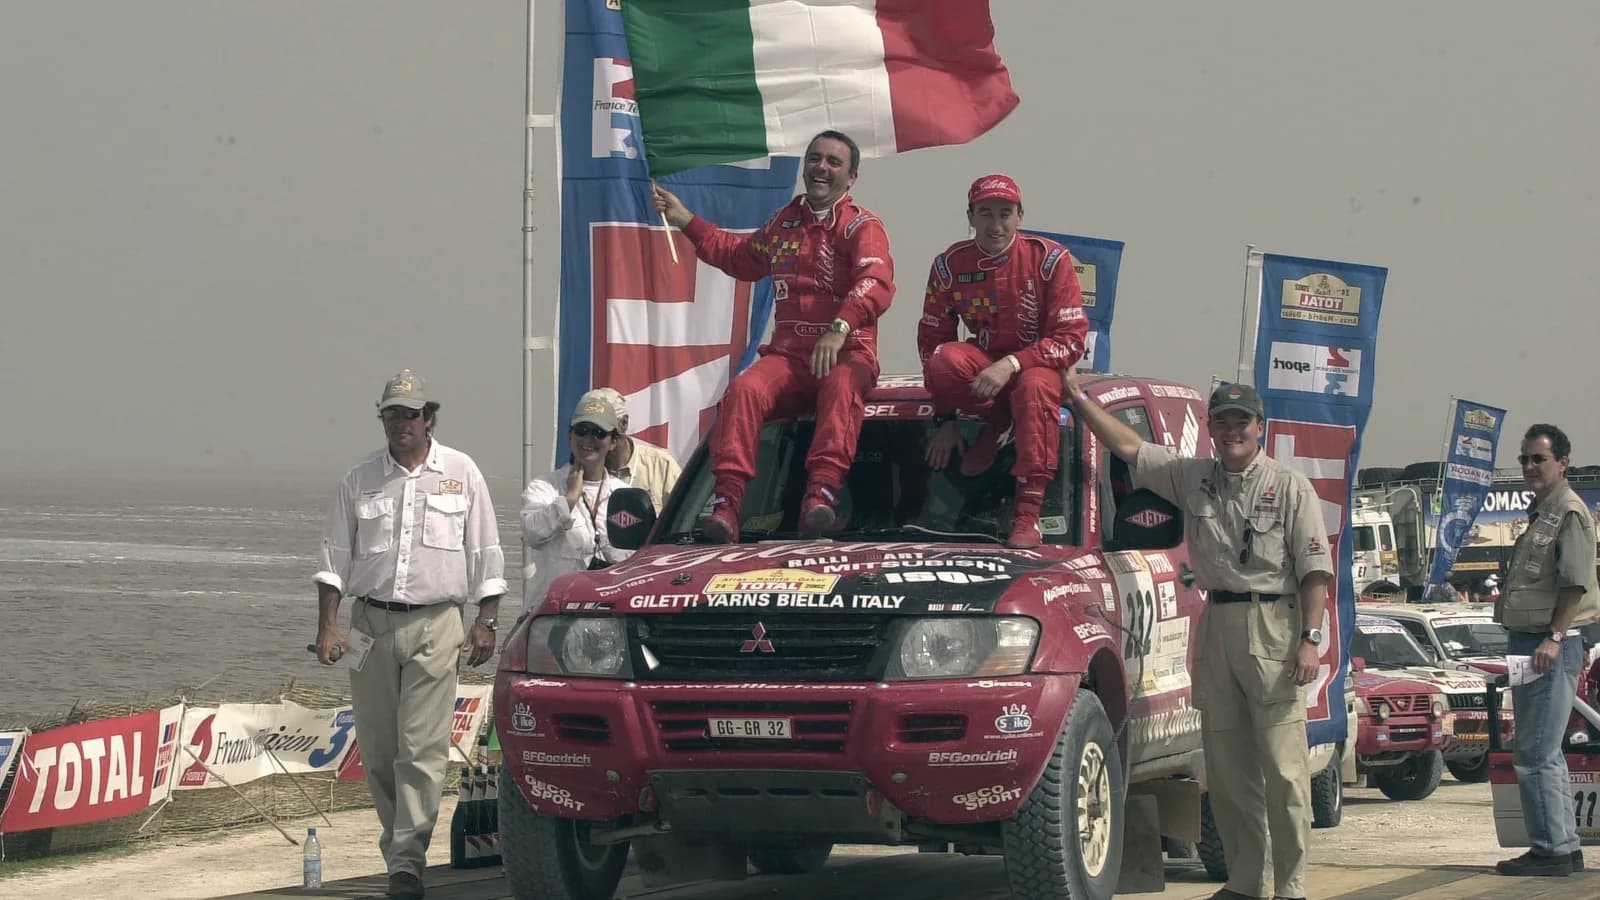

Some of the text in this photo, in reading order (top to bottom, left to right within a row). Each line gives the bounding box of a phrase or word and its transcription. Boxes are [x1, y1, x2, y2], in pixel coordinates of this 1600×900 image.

[863, 405, 899, 417] SEL
[1480, 490, 1536, 512] OMAS
[788, 552, 924, 568] RALLI ART
[823, 558, 1006, 573] MITSUBISHI
[738, 582, 801, 591] TOTAL
[630, 593, 906, 609] GILETTI YARNS BIELLA ITALY
[640, 681, 868, 690] www.ralliart.com
[1446, 679, 1488, 690] Castro
[453, 713, 473, 732] TAL
[717, 719, 785, 736] GG-GR 32
[522, 750, 591, 765] BFGoodrich
[928, 749, 1017, 763] BFGoodrich
[28, 731, 145, 814] TOTAL
[1569, 773, 1593, 783] OTAL
[524, 774, 571, 798] GECO
[530, 786, 585, 812] SPORT
[952, 785, 1005, 805] GECO
[964, 787, 1022, 811] SPORT
